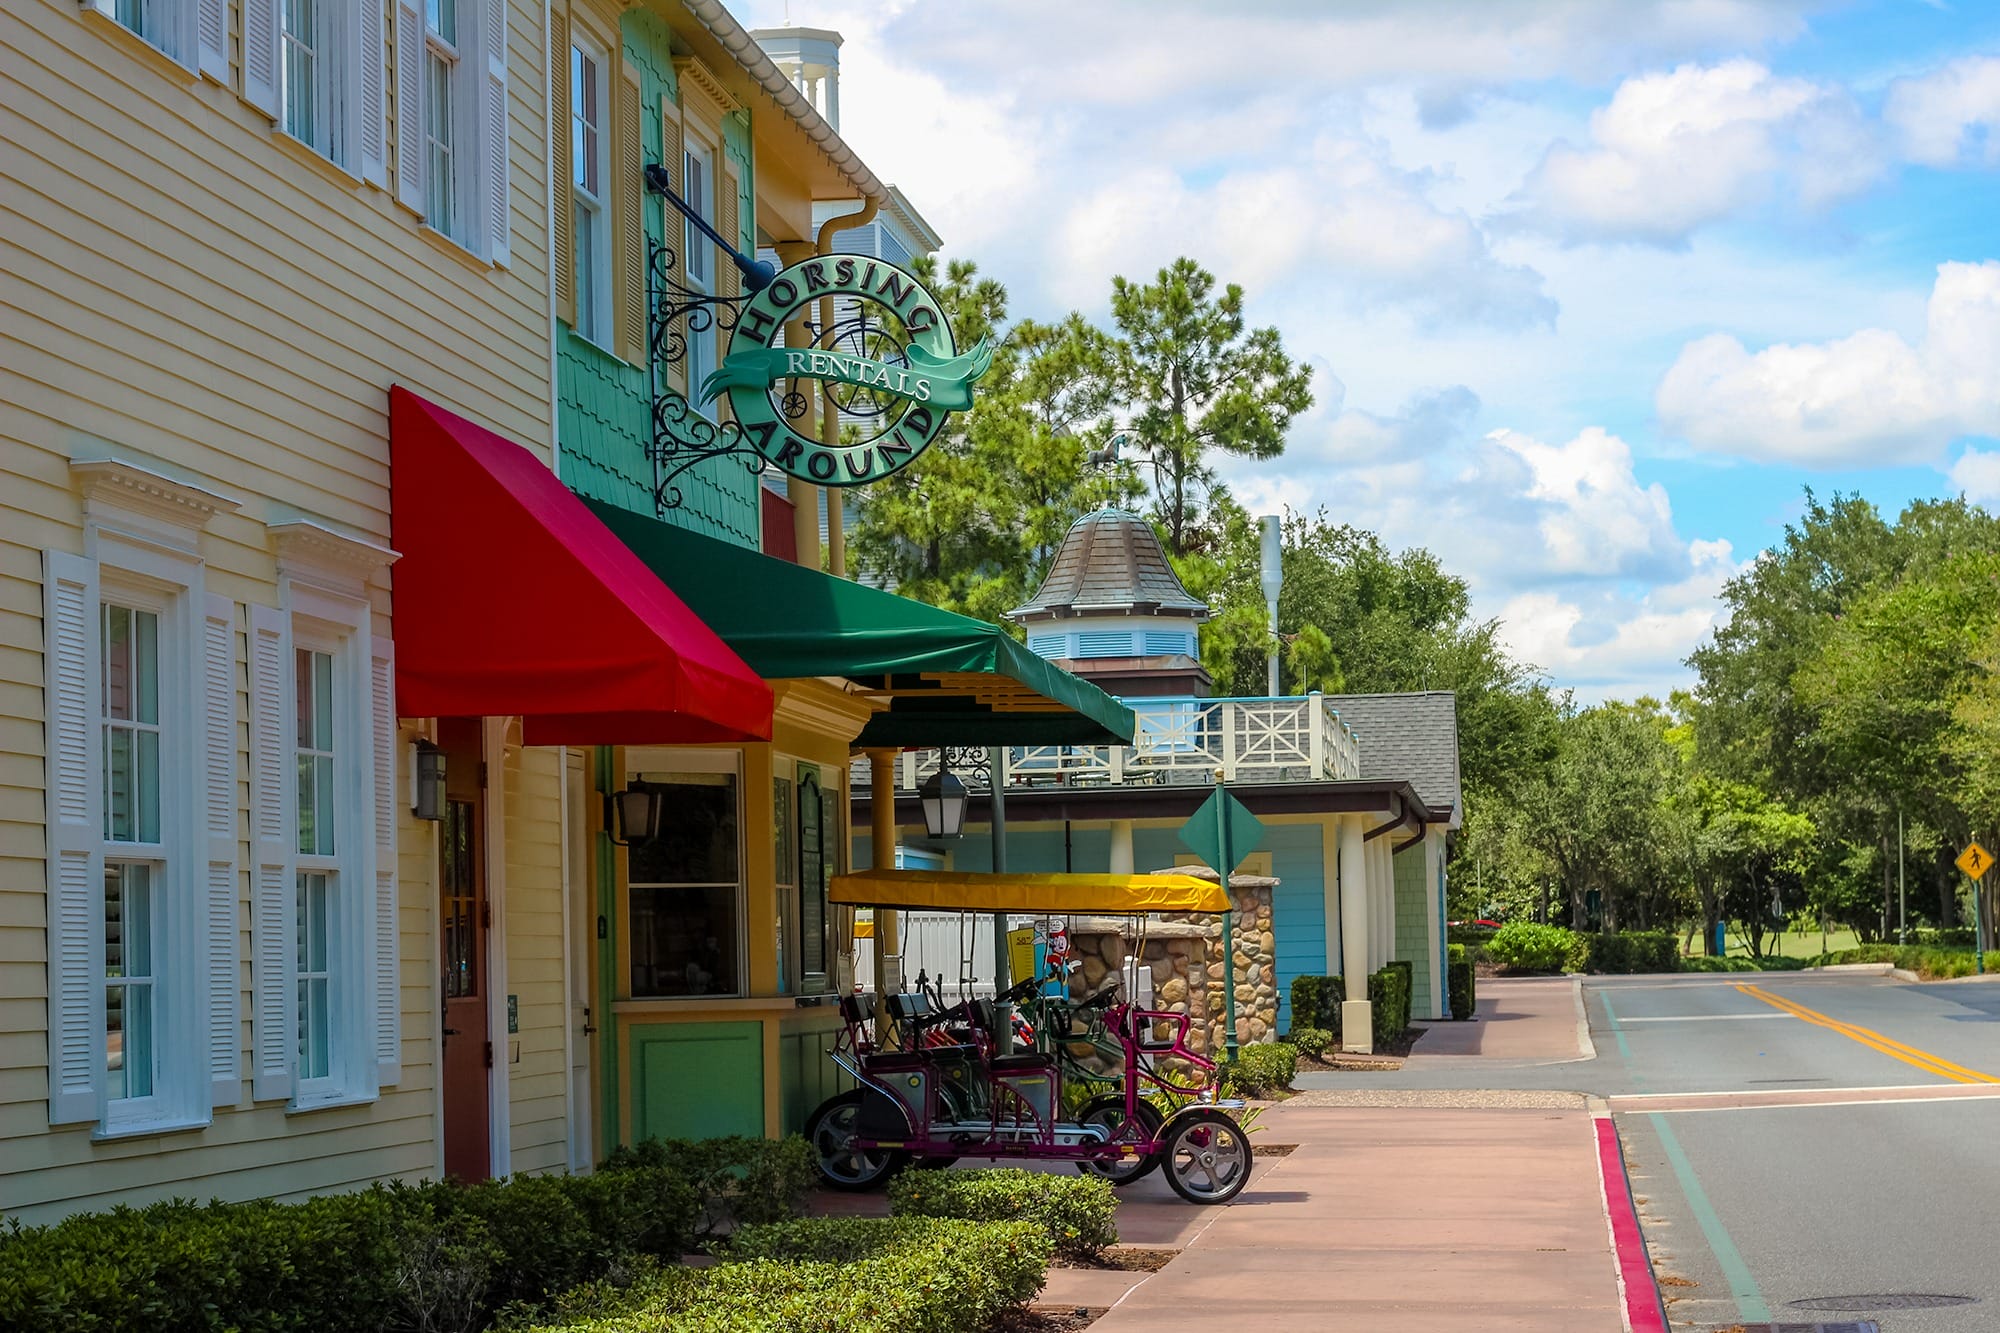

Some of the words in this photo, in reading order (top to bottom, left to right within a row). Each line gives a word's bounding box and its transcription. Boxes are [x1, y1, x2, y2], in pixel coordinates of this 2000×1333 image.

[739, 258, 938, 344] HORSING
[786, 352, 931, 401] RENTALS
[746, 407, 932, 479] AROUND
